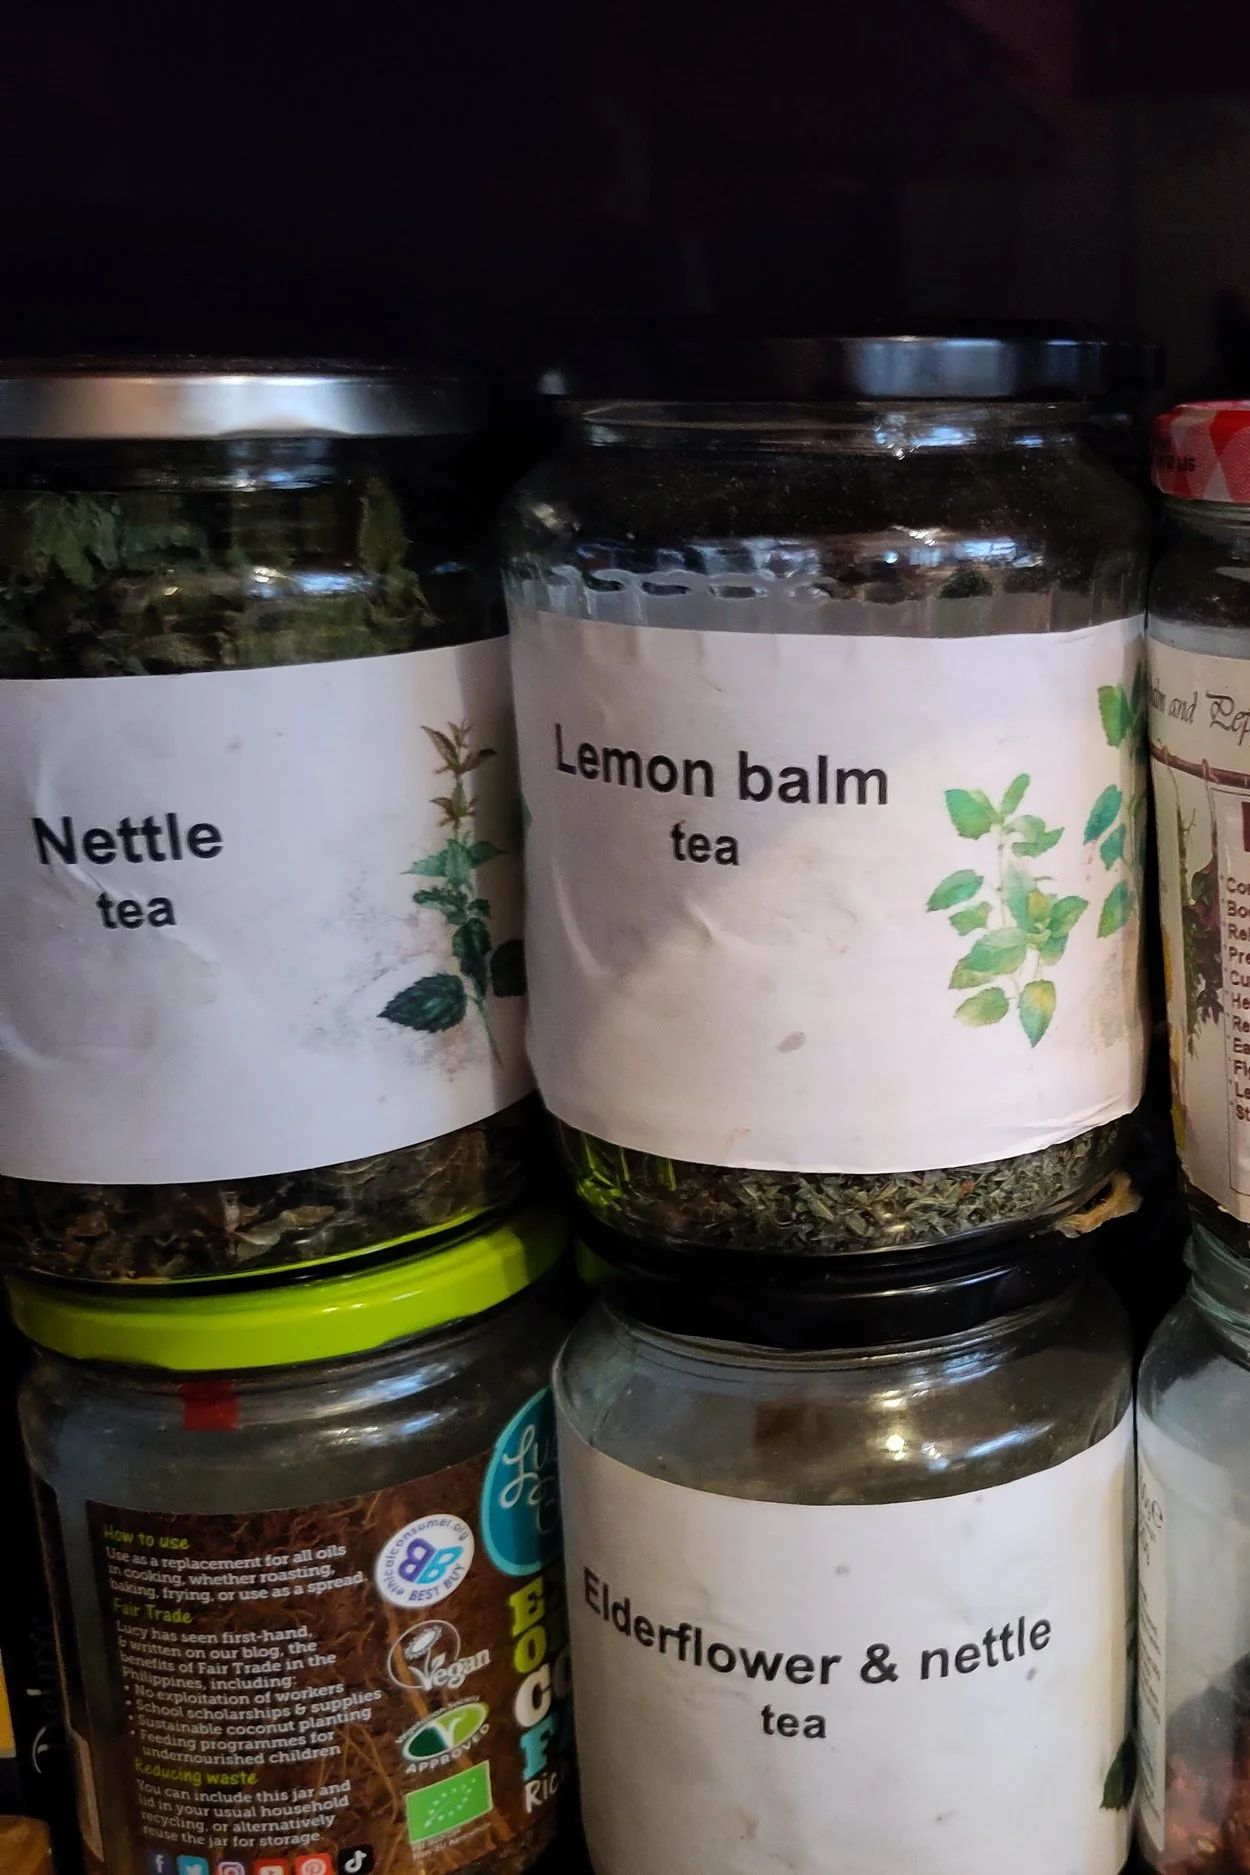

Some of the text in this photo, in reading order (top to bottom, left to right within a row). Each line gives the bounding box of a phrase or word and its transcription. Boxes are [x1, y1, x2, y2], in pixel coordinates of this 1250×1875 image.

[1169, 691, 1198, 724] and
[554, 724, 889, 805] Lemon balm
[32, 811, 225, 867] Nettle
[671, 820, 740, 867] tea
[97, 891, 176, 931] tea
[104, 1523, 190, 1550] How to use
[106, 1545, 347, 1571] Use as a replacement for all oils
[108, 1564, 336, 1588] in cooking, whether roasting,
[110, 1578, 160, 1599] baking,
[217, 1589, 235, 1601] or
[239, 1588, 268, 1600] use
[272, 1586, 291, 1597] as
[293, 1584, 304, 1595] a
[307, 1571, 368, 1595] spread.
[408, 1563, 465, 1602] BEST BUY
[113, 1599, 193, 1624] Fair Trade
[116, 1620, 313, 1644] Lucy has seen first-hand,
[584, 1566, 841, 1685] Elderflower
[859, 1642, 899, 1685] &
[919, 1615, 1052, 1681] nettle
[130, 1639, 182, 1657] written
[186, 1648, 207, 1659] on
[210, 1648, 240, 1660] our
[242, 1645, 285, 1660] blog,
[288, 1641, 317, 1655] the
[120, 1653, 337, 1675] benefits of Fair Trade in the
[407, 1649, 491, 1692] Vegan
[122, 1666, 298, 1691] Philippines, including:
[134, 1683, 345, 1707] No exploitation of workers
[136, 1689, 382, 1721] School scholarships & supplies
[137, 1715, 223, 1736] Sustainable
[226, 1720, 297, 1736] coconut
[298, 1707, 372, 1731] planting
[761, 1703, 827, 1740] tea
[140, 1729, 336, 1754] Feeding programmes for
[142, 1745, 342, 1766] undernourished children
[134, 1758, 258, 1787] Reducing waste
[137, 1779, 351, 1804] You can include this jar and
[160, 1800, 172, 1811] in
[176, 1803, 211, 1819] your
[213, 1804, 257, 1818] usual
[260, 1795, 350, 1817] household
[140, 1811, 337, 1833] recycling, or alternatively
[143, 1825, 325, 1849] reuse the jar for storage.
